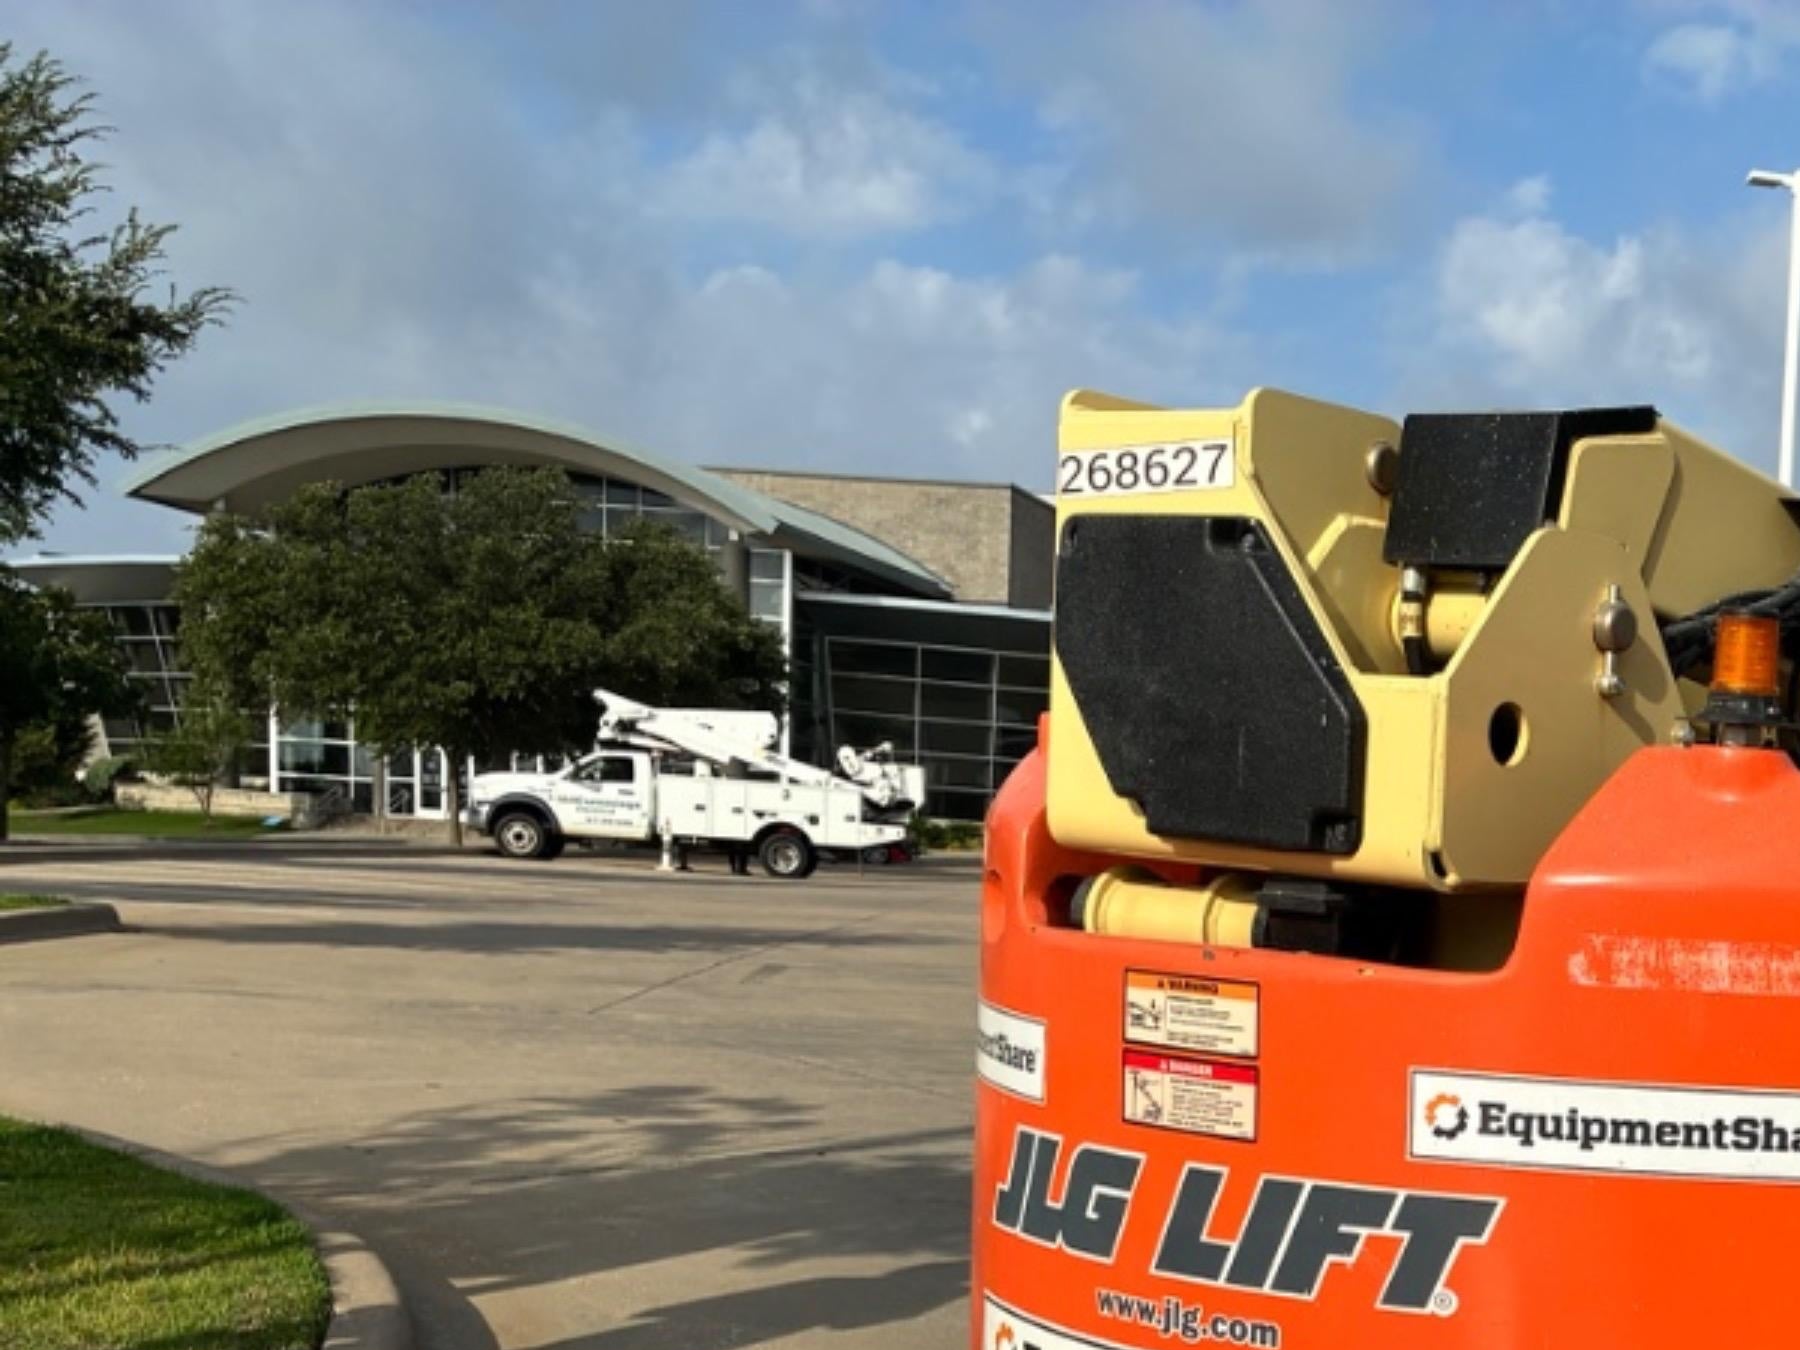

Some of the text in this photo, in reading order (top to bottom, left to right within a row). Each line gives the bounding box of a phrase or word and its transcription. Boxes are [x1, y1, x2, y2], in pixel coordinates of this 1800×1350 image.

[1060, 443, 1229, 494] 268627
[993, 1125, 1507, 1314] JLG LIFT
[1096, 1290, 1281, 1349] www.jlg.com
